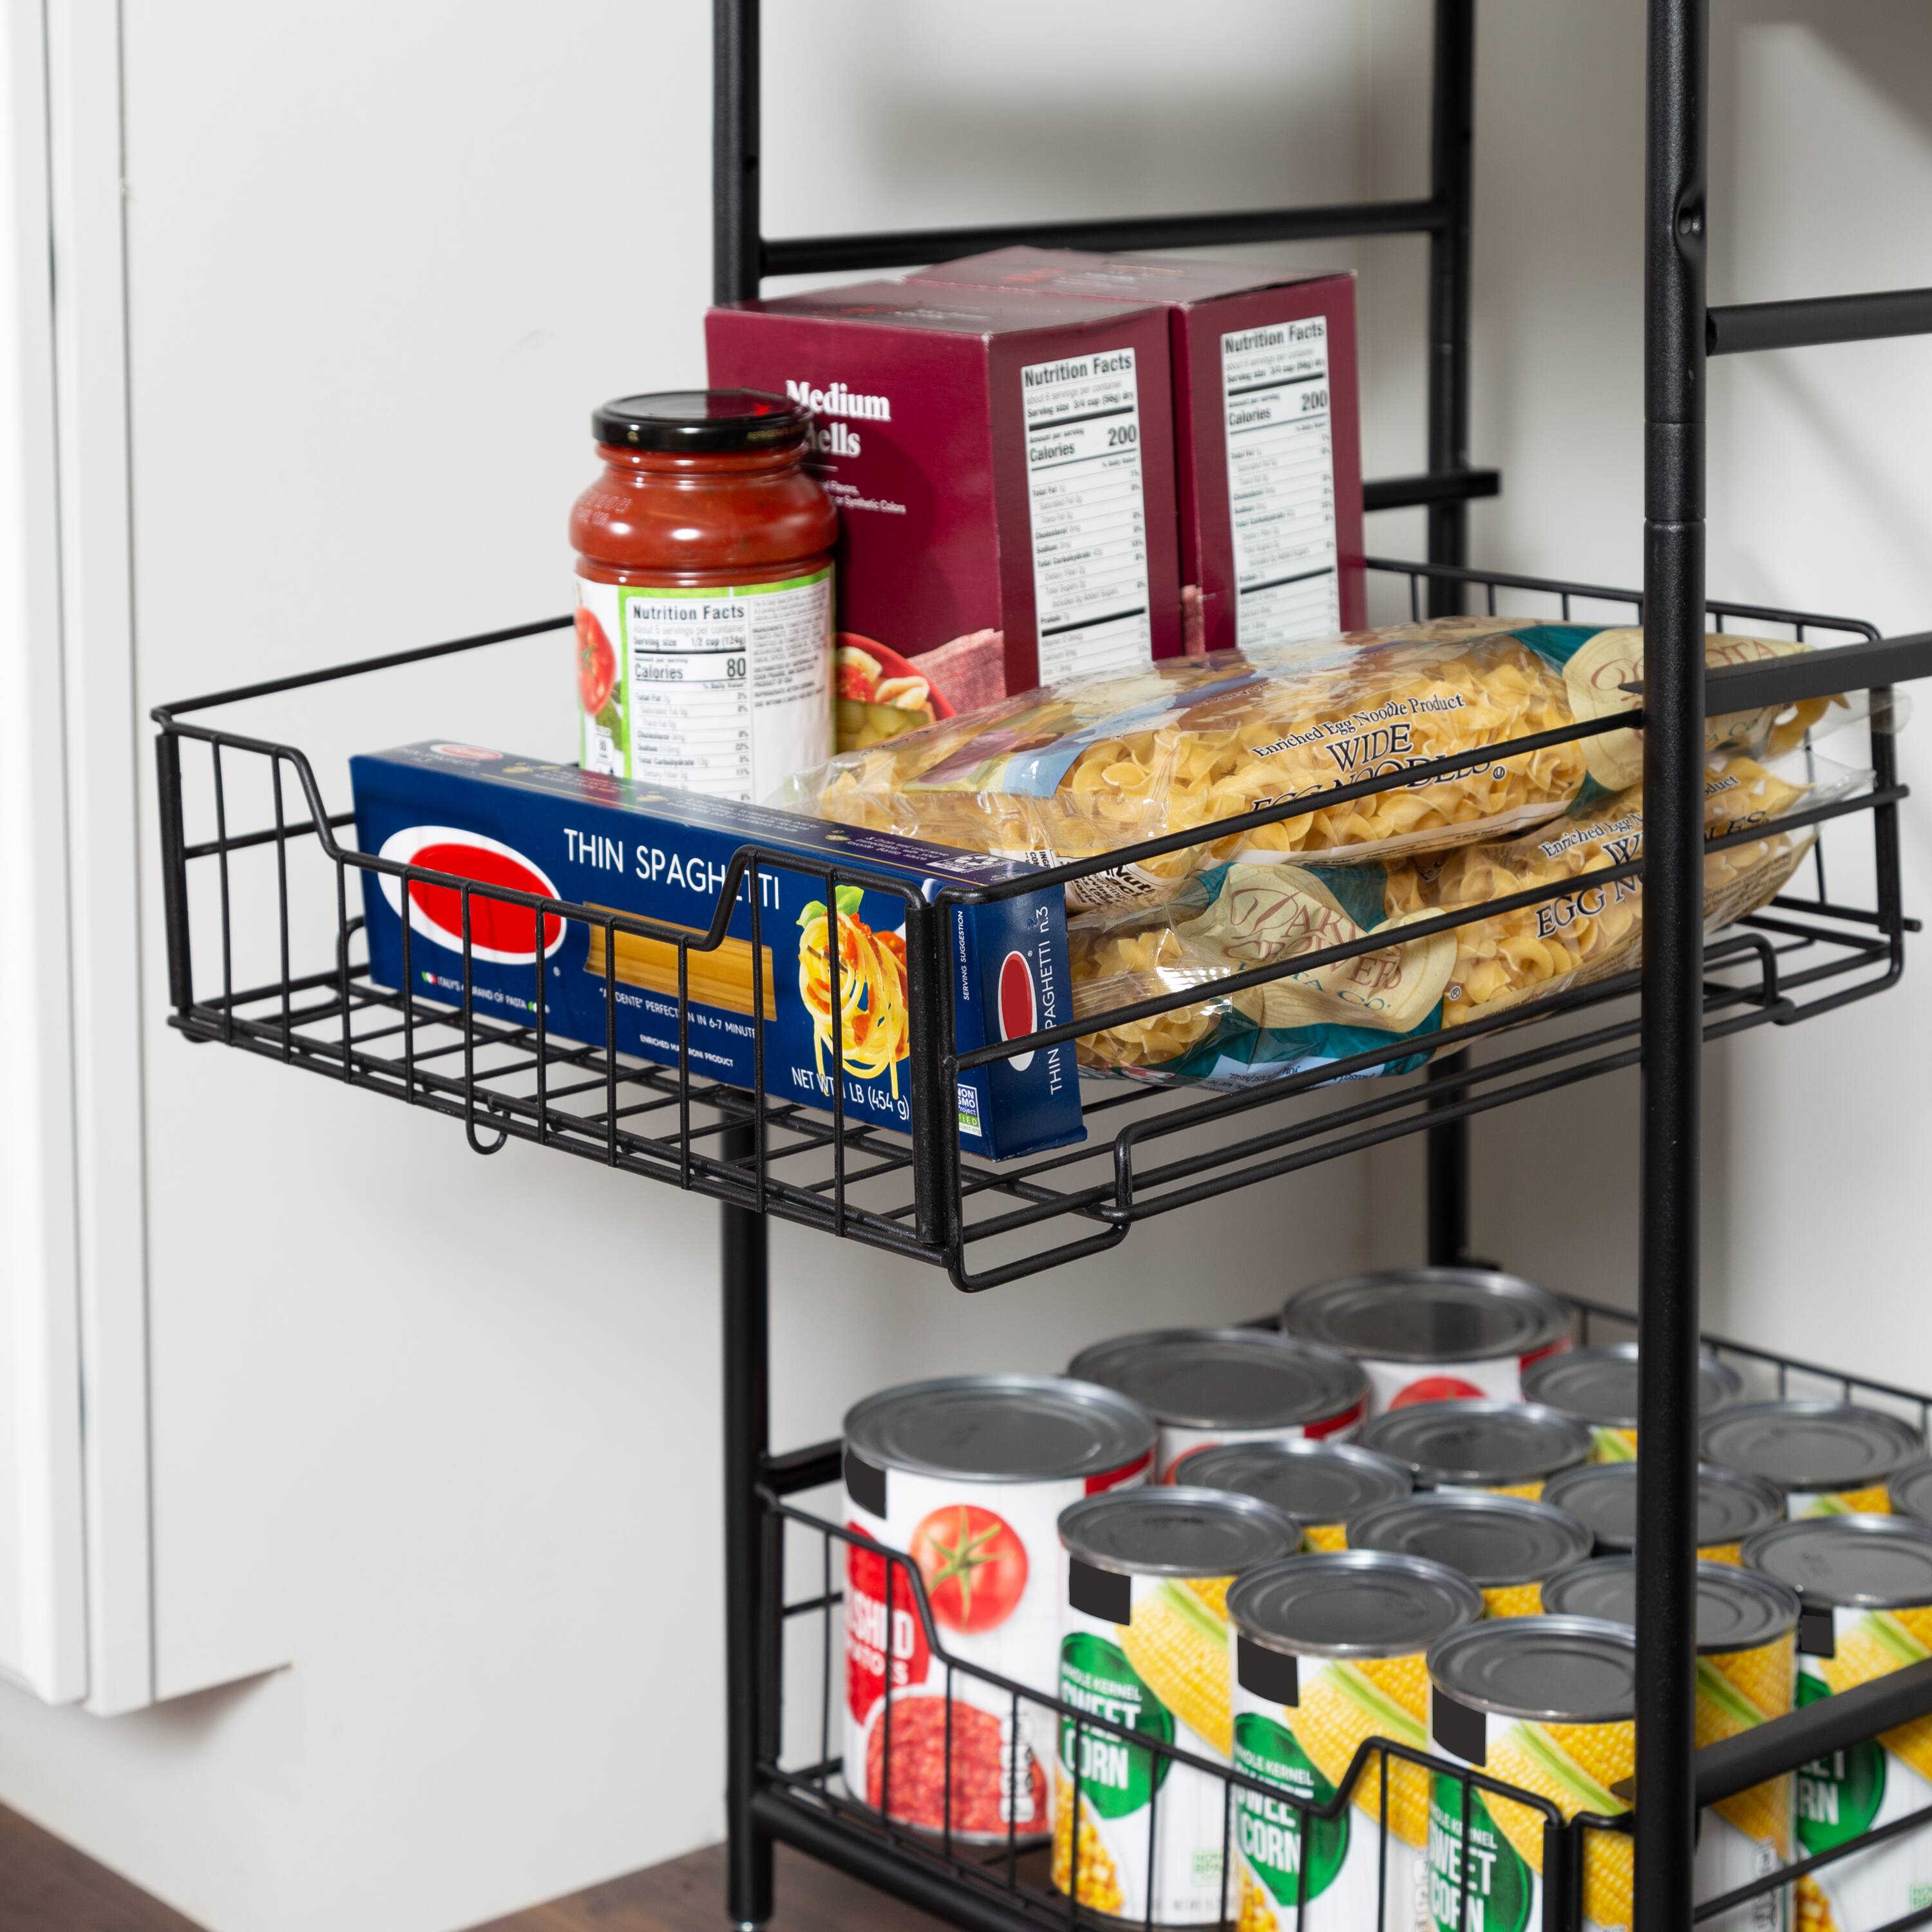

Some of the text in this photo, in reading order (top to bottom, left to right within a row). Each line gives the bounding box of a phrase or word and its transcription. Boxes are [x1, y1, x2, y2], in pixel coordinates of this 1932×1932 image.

[1226, 322, 1324, 353] Nutrition Facts
[1025, 354, 1132, 387] Nutrition Facts
[785, 380, 891, 422] Medium
[1028, 405, 1053, 417] Serving
[1056, 402, 1069, 412] size
[1087, 397, 1099, 407] cup
[1229, 390, 1328, 426] Calories 200
[1030, 424, 1137, 462] Calories 200
[634, 604, 744, 620] Nutrition Facts
[634, 636, 746, 648] Serving size 1/2 cup (124g)
[635, 663, 683, 679] Calories
[727, 658, 746, 677] 80
[1251, 692, 1465, 758] Enriched Egg Noodle Product
[1326, 723, 1412, 773] WIDE
[564, 828, 623, 873] THIN
[1539, 824, 1604, 858] Enriched
[1536, 887, 1605, 939] EGG
[958, 911, 966, 962] SUGGESTION
[437, 976, 460, 992] ITALY'S
[494, 992, 504, 1003] OF
[506, 996, 527, 1009] PASTA
[1036, 906, 1063, 1095] THIN PAGHETTI n.3
[645, 1000, 694, 1023] PERFECTN
[697, 1014, 706, 1025] IN
[709, 1018, 721, 1030] 6-7
[639, 1034, 669, 1050] ENRICHED
[705, 1053, 734, 1066] PRODUCT
[791, 1066, 814, 1090] NET
[817, 1074, 833, 1095] WT
[849, 1082, 864, 1103] LB
[868, 1086, 893, 1112] (454
[898, 1095, 909, 1121] g)
[1097, 1676, 1142, 1702] KERNEL
[1265, 1759, 1314, 1786] KERNEL
[1242, 1819, 1302, 1874] CORN
